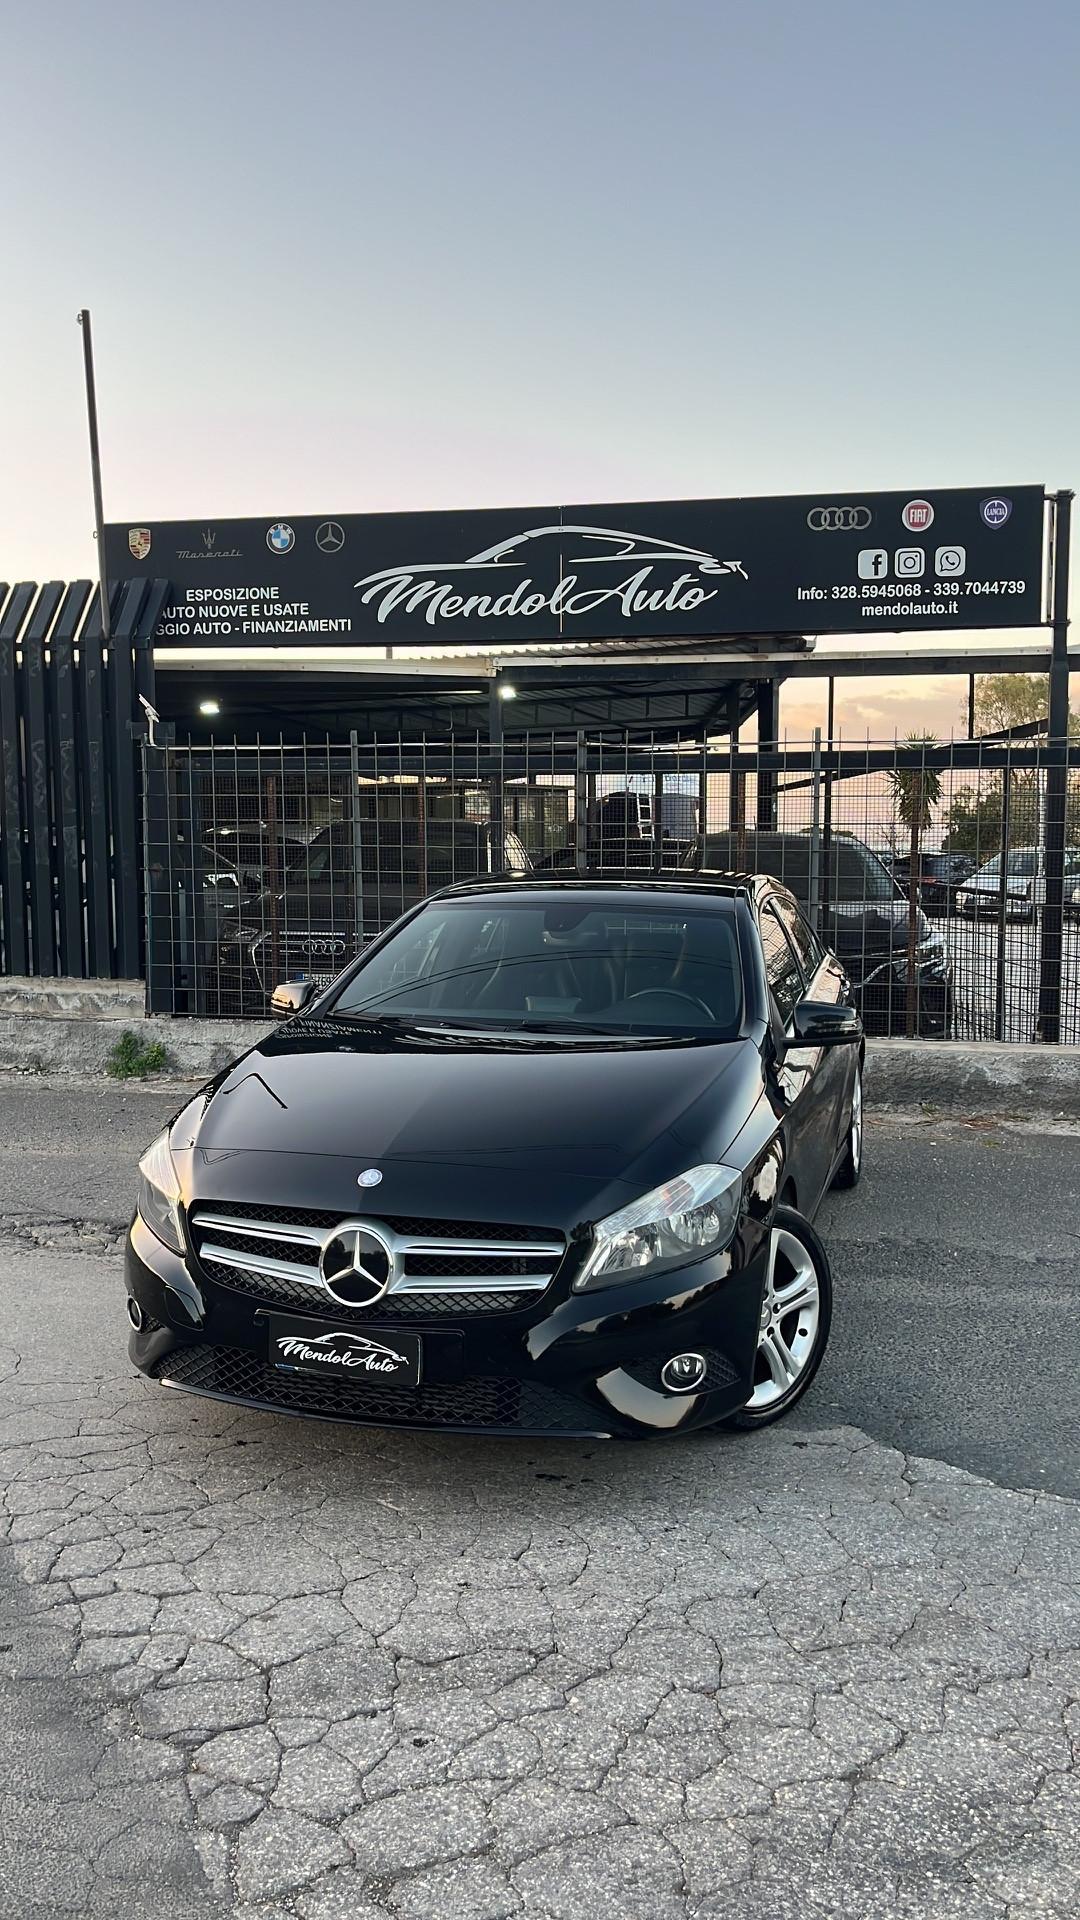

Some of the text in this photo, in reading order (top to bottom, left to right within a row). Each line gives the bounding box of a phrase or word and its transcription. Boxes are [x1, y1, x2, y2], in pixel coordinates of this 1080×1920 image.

[909, 508, 928, 523] FIAT
[986, 508, 1005, 516] LANCIA
[176, 549, 243, 559] Maserati
[186, 587, 279, 602] ESPOSIZIONE
[797, 587, 828, 600] Info:
[831, 584, 922, 599] 328.5945068
[933, 581, 1026, 596] 339.7044739
[199, 604, 248, 618] NUOVE
[251, 604, 260, 616] E
[263, 602, 309, 617] USATE
[861, 601, 959, 616] mendolauto.it
[193, 621, 231, 635] AUTO
[242, 619, 352, 634] FINANZIAMENTI
